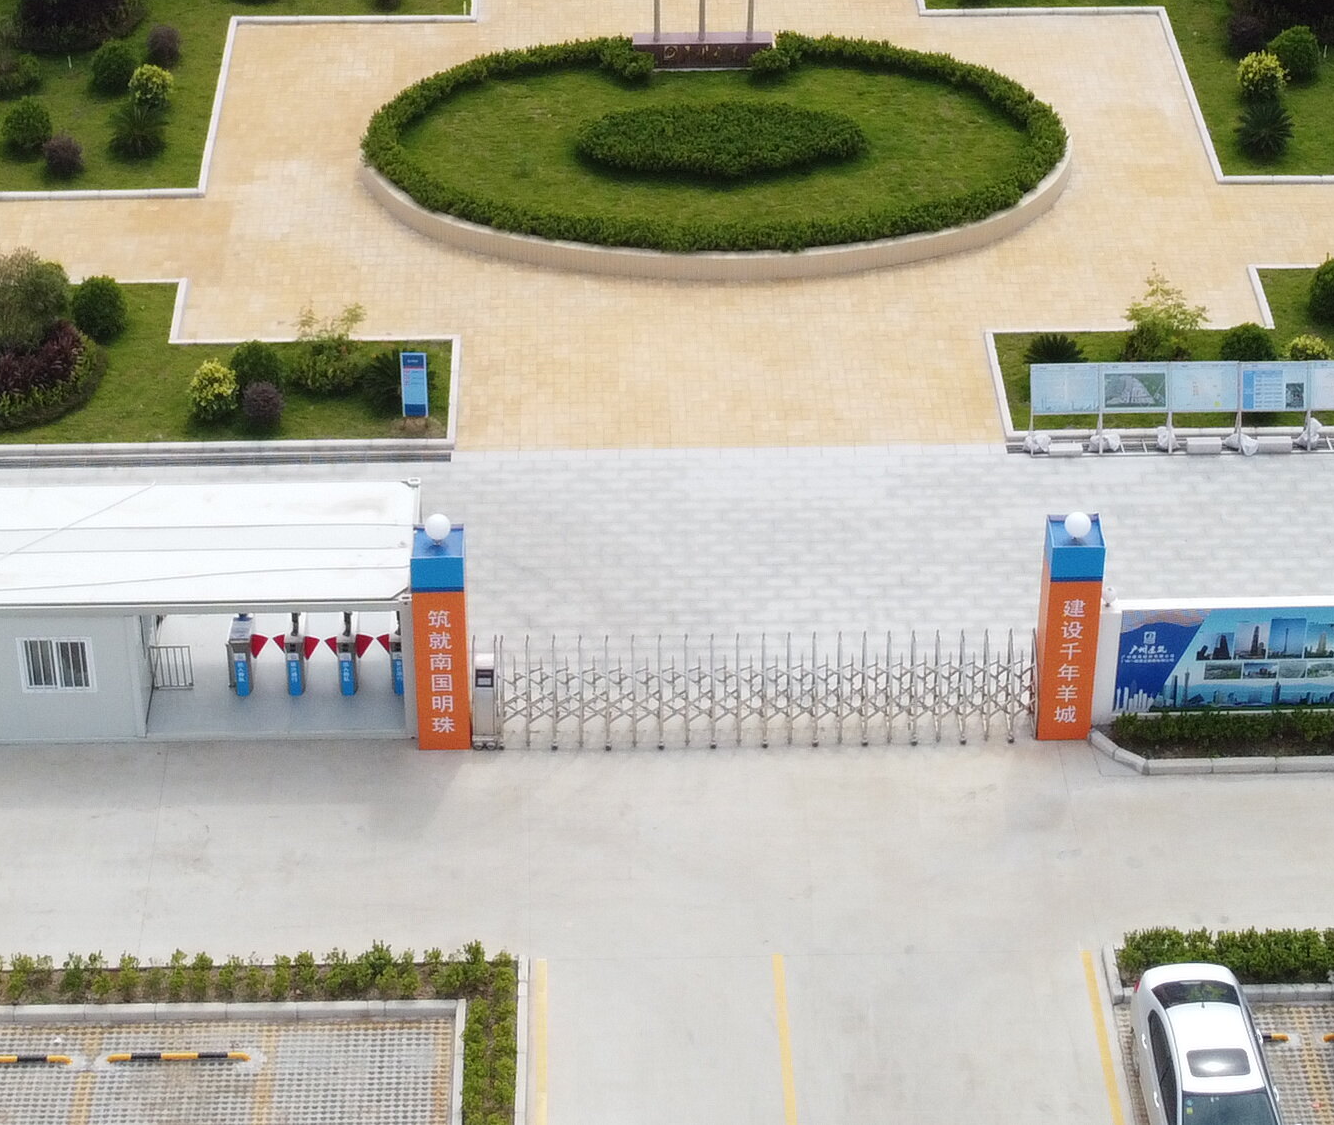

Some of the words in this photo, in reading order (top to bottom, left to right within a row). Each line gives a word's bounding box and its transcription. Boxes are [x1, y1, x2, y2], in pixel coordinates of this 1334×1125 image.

[427, 609, 455, 733] 筑就南国明珠
[1054, 599, 1086, 723] 建设千年羊城
